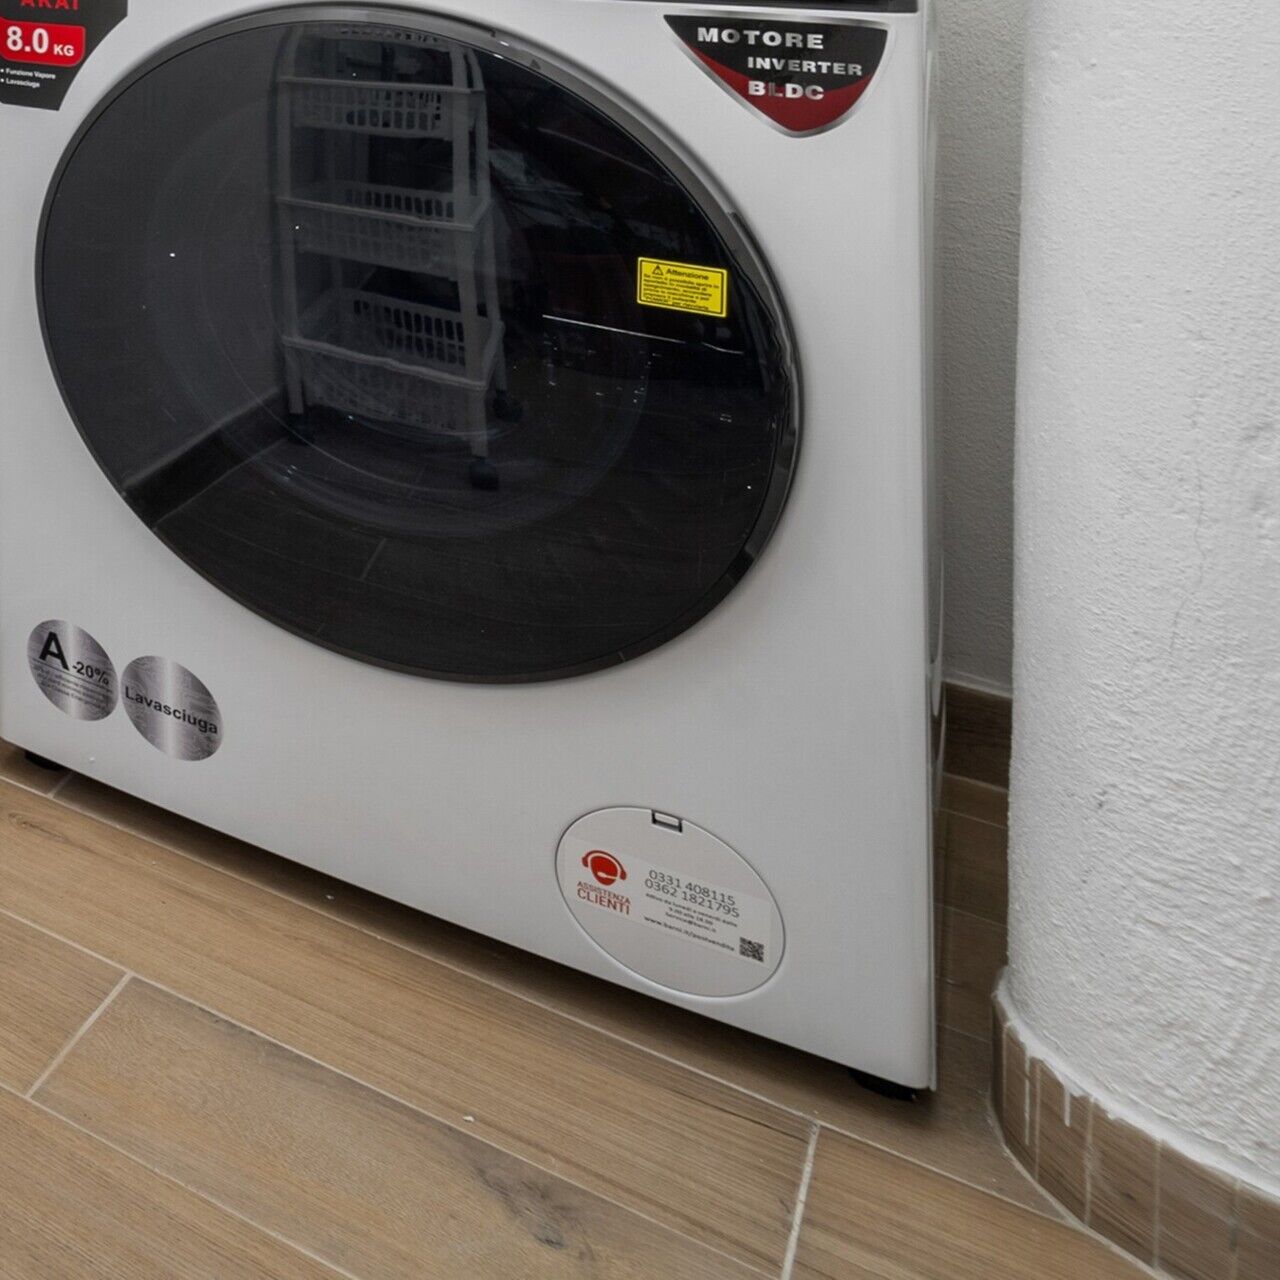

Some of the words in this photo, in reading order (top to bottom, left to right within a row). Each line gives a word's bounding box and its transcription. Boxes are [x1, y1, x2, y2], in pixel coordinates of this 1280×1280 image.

[6, 25, 49, 54] 8.0
[53, 44, 75, 57] KG
[697, 27, 824, 50] MOTORE
[6, 68, 33, 77] Funzione
[34, 70, 56, 80] Vapore
[747, 56, 863, 76] INVERTER
[6, 78, 40, 88] Lavasciuga
[748, 80, 825, 100] BLDC
[666, 268, 709, 280] Attenzione
[38, 631, 70, 671] A
[72, 660, 110, 686] -20%
[125, 686, 218, 735] Lavasciuga
[577, 881, 631, 905] ASSISTENZA
[644, 878, 677, 898] 0362
[682, 890, 740, 918] 1821795
[649, 869, 681, 889] 0331
[685, 882, 736, 906] 408115
[577, 887, 630, 915] CLIENTI
